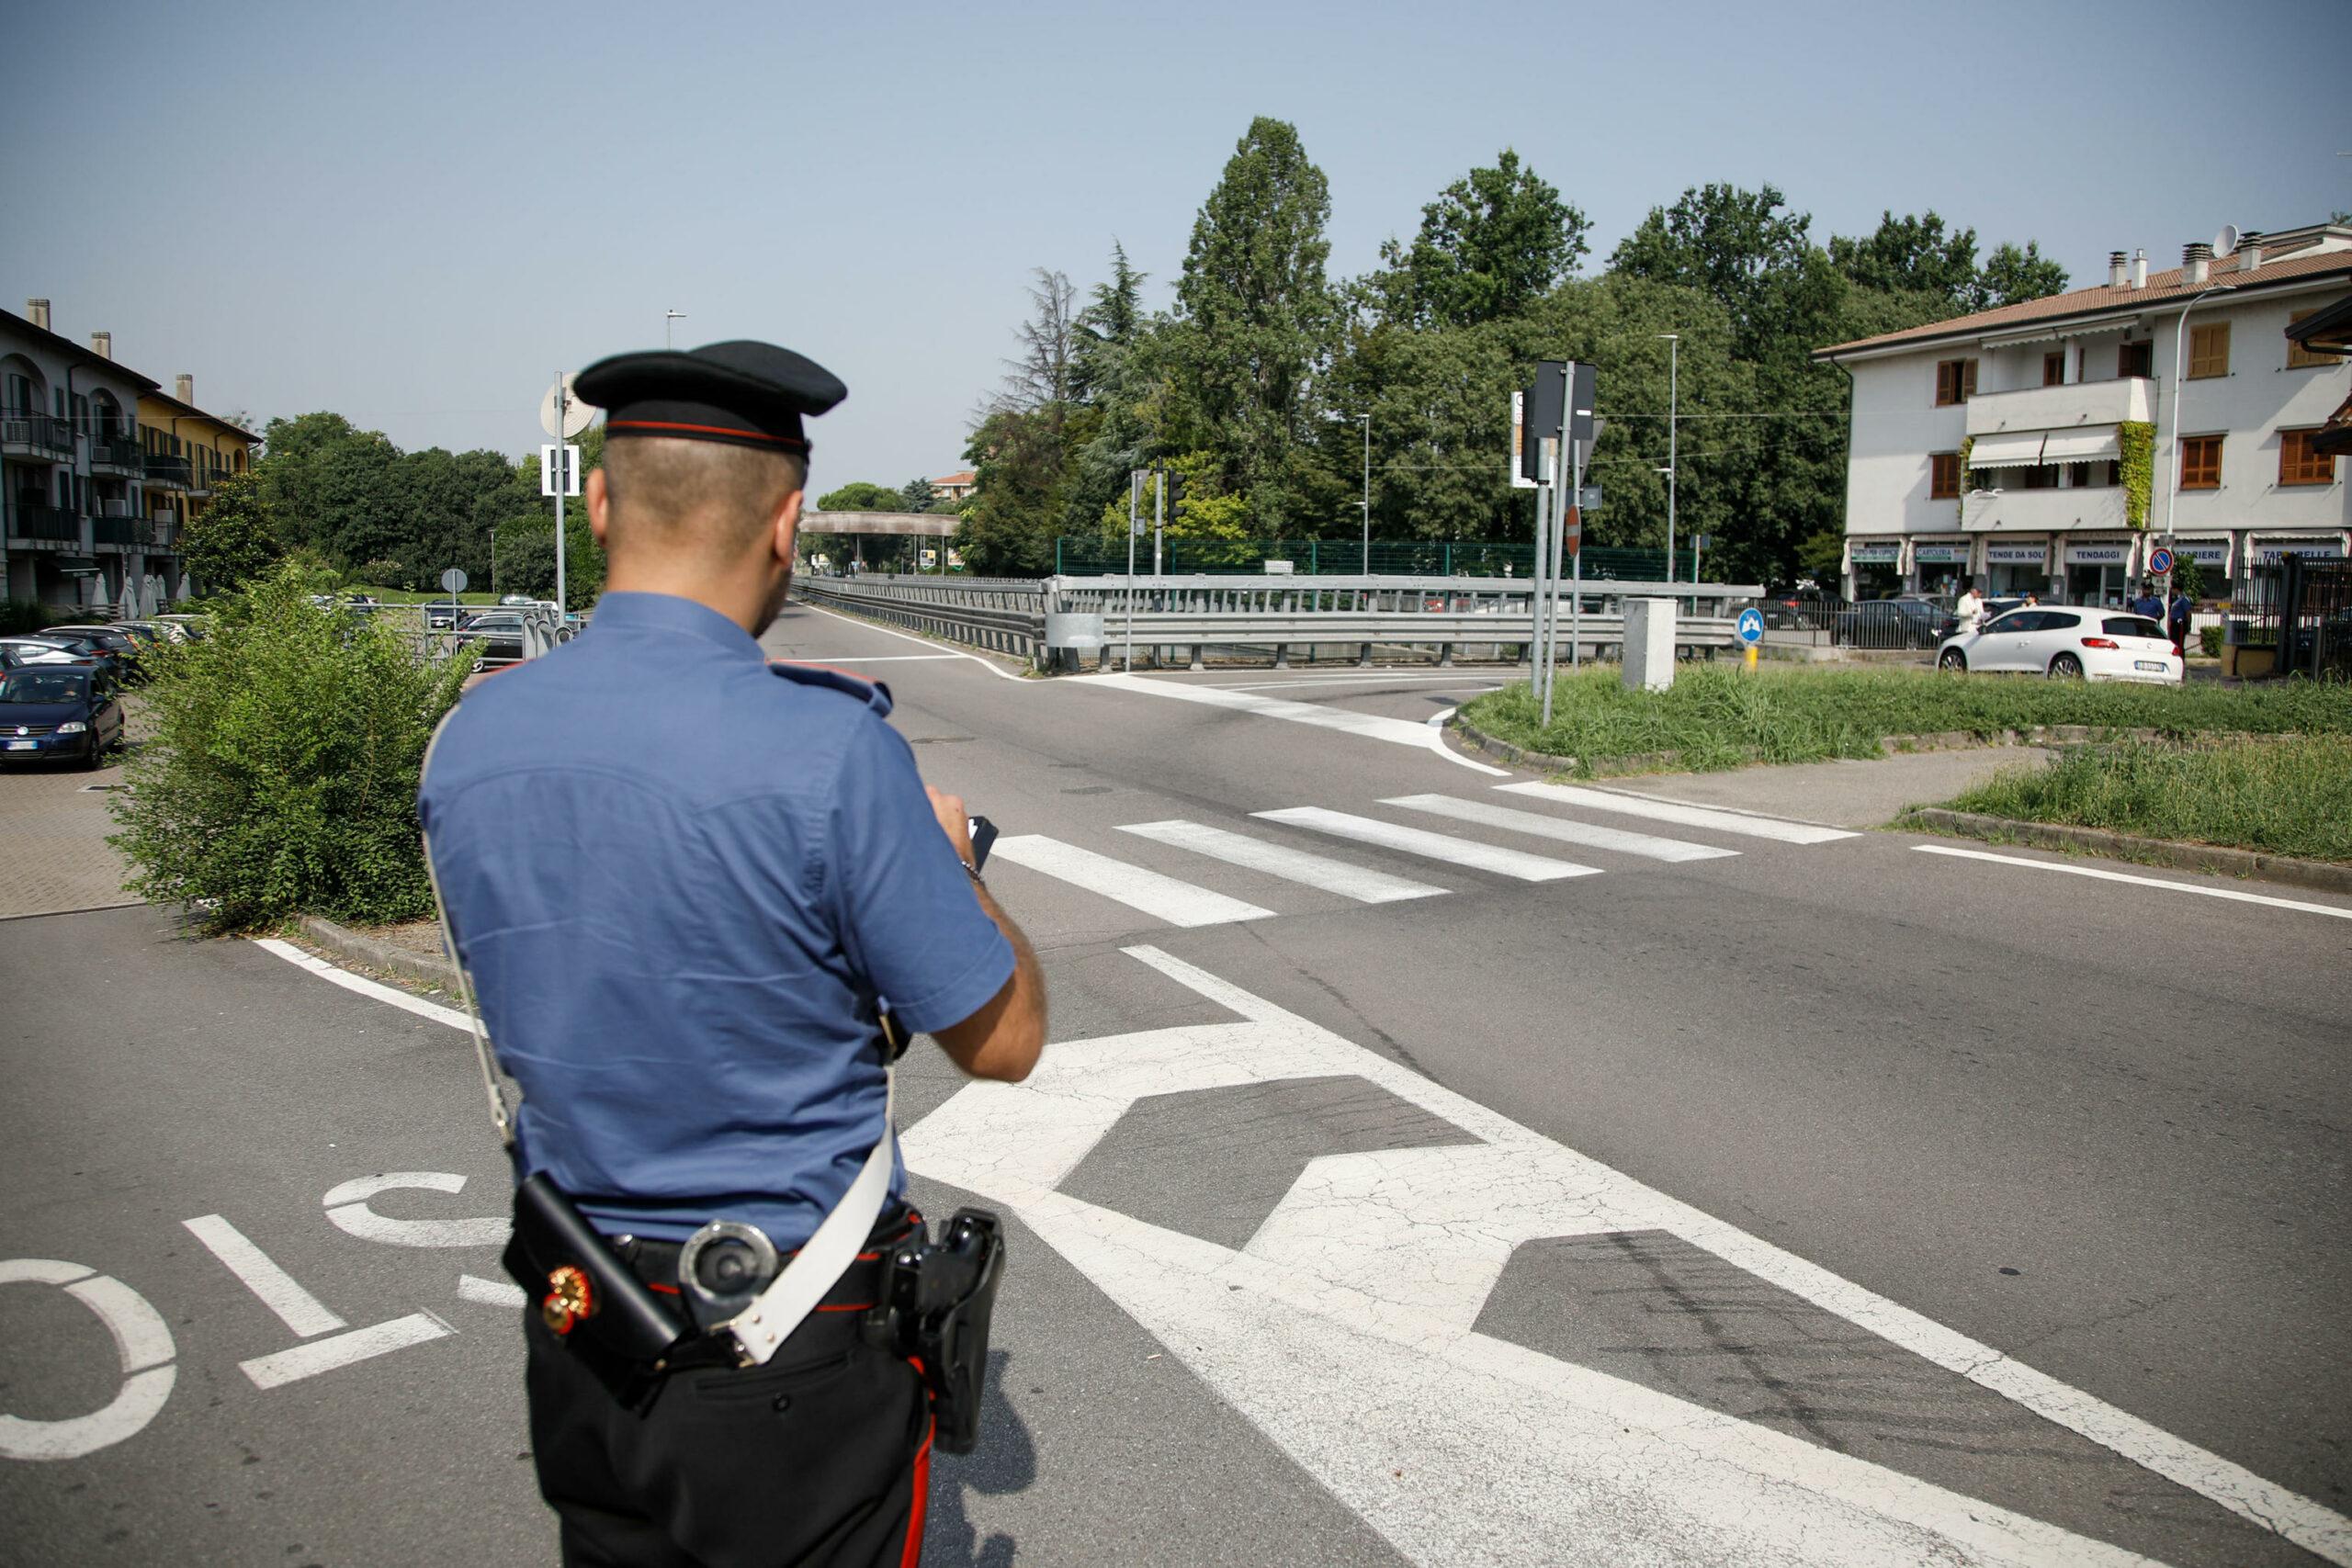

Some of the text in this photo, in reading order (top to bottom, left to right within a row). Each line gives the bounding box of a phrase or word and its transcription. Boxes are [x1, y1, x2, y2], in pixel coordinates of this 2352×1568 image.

[1989, 550, 2013, 558] TENDE
[2015, 550, 2026, 558] DA
[2076, 550, 2120, 558] TENDAGGI
